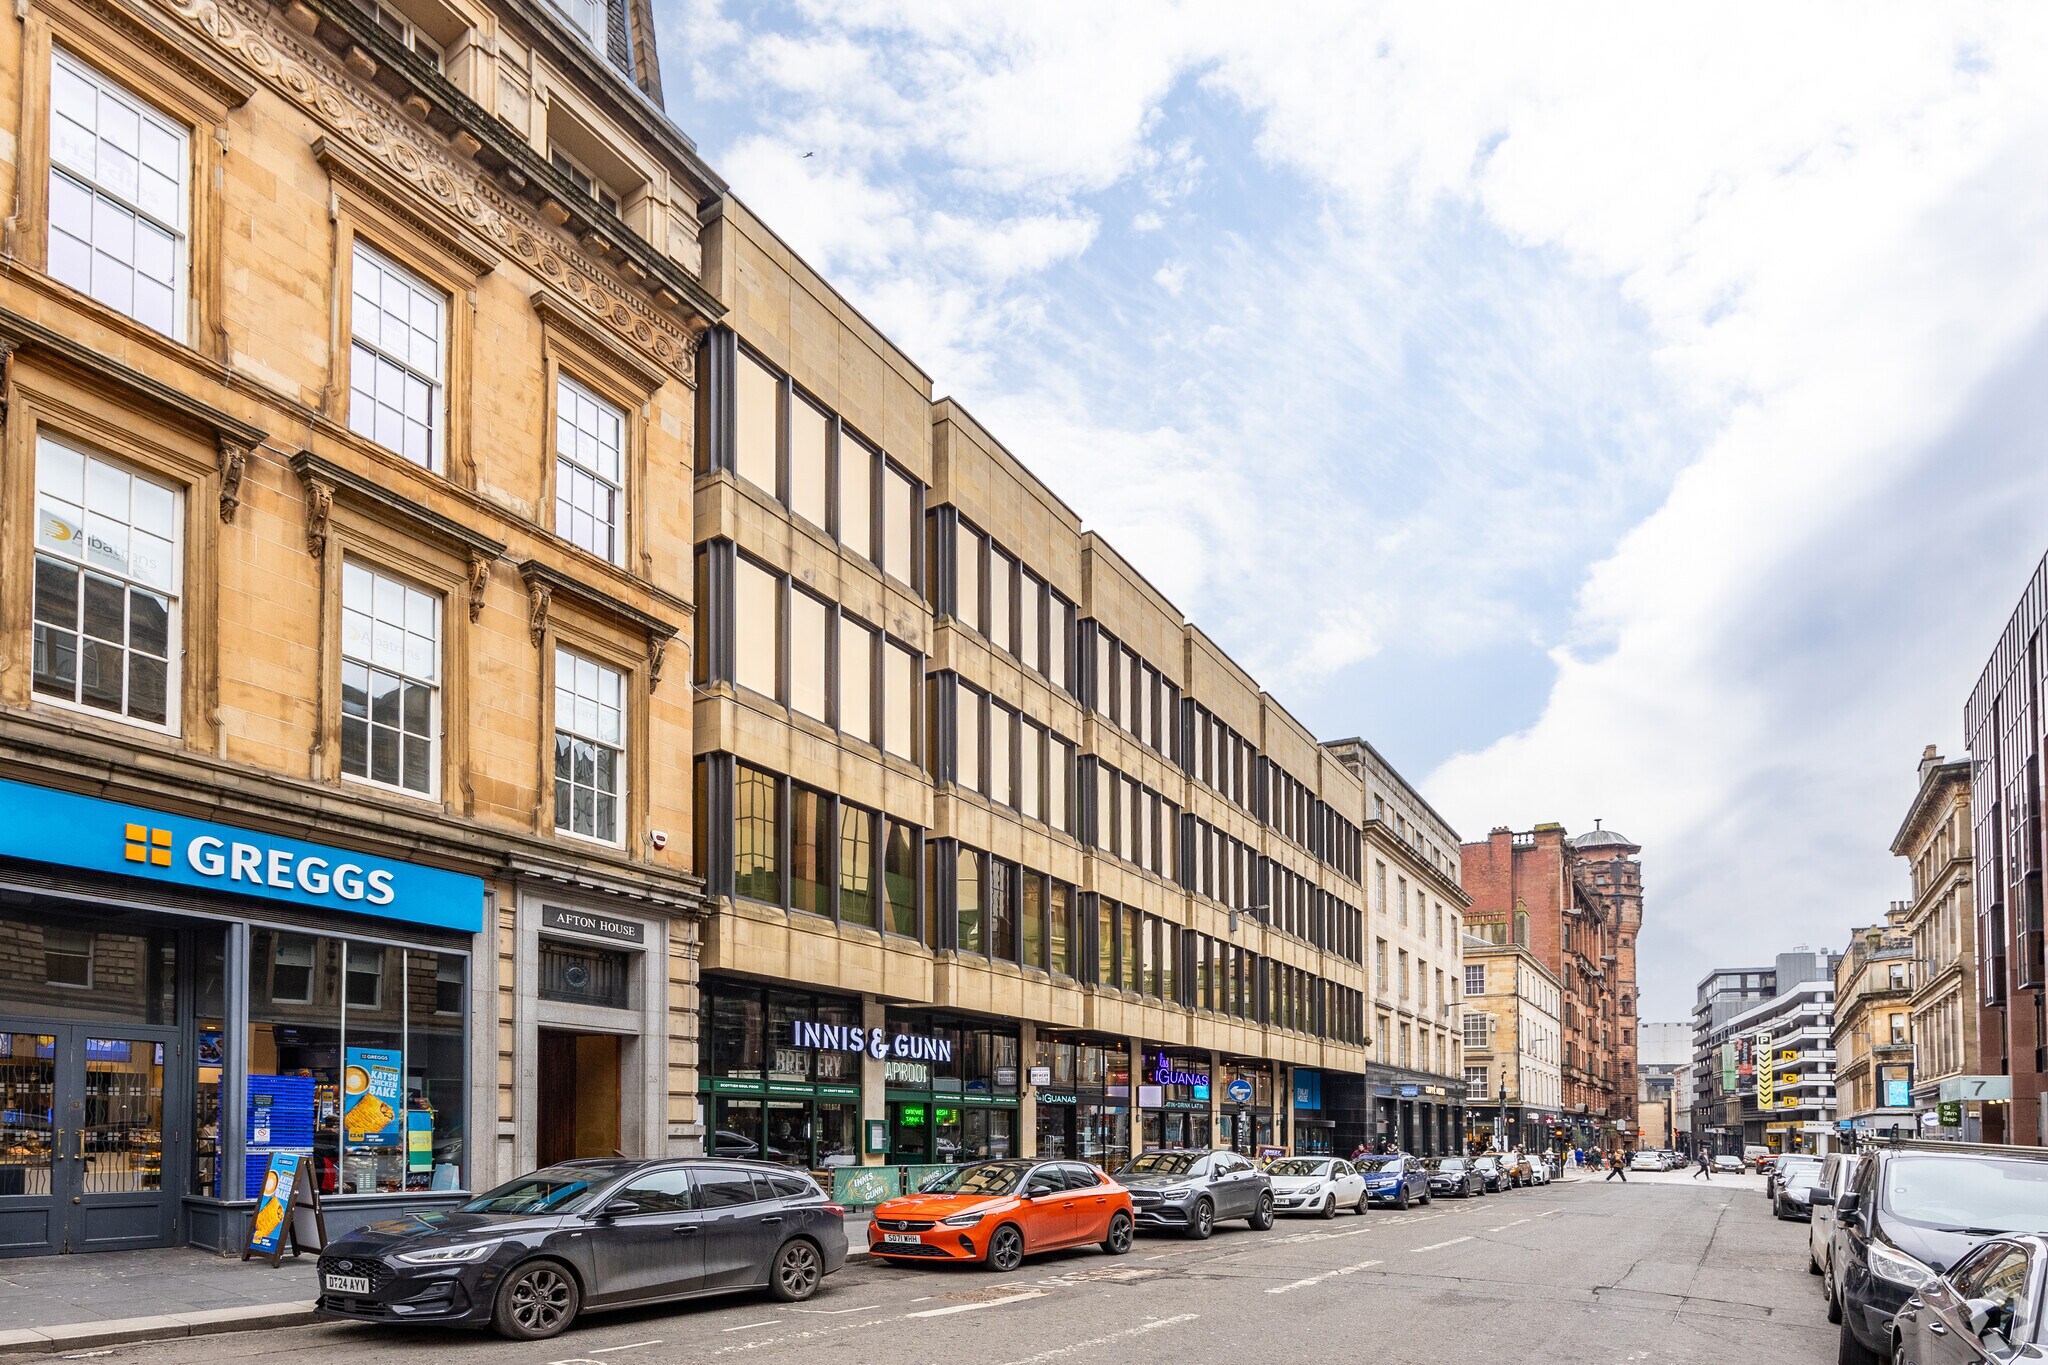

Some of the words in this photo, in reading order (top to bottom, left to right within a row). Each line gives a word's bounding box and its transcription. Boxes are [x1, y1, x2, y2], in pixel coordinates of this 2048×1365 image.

[187, 836, 395, 905] GREGGS
[556, 913, 596, 929] AFTON
[600, 920, 636, 937] HOUSE
[794, 1020, 865, 1052] INNIS
[868, 1027, 890, 1060] &
[894, 1034, 951, 1062] GUNN
[370, 1079, 397, 1088] CHICKEN
[371, 1070, 398, 1082] KATSU
[369, 1085, 397, 1098] BAKE
[1971, 1080, 1987, 1097] 7
[854, 1172, 874, 1187] INNIS
[865, 1186, 884, 1201] GUNN
[329, 1276, 348, 1290] DT24
[350, 1278, 366, 1292] AYV
